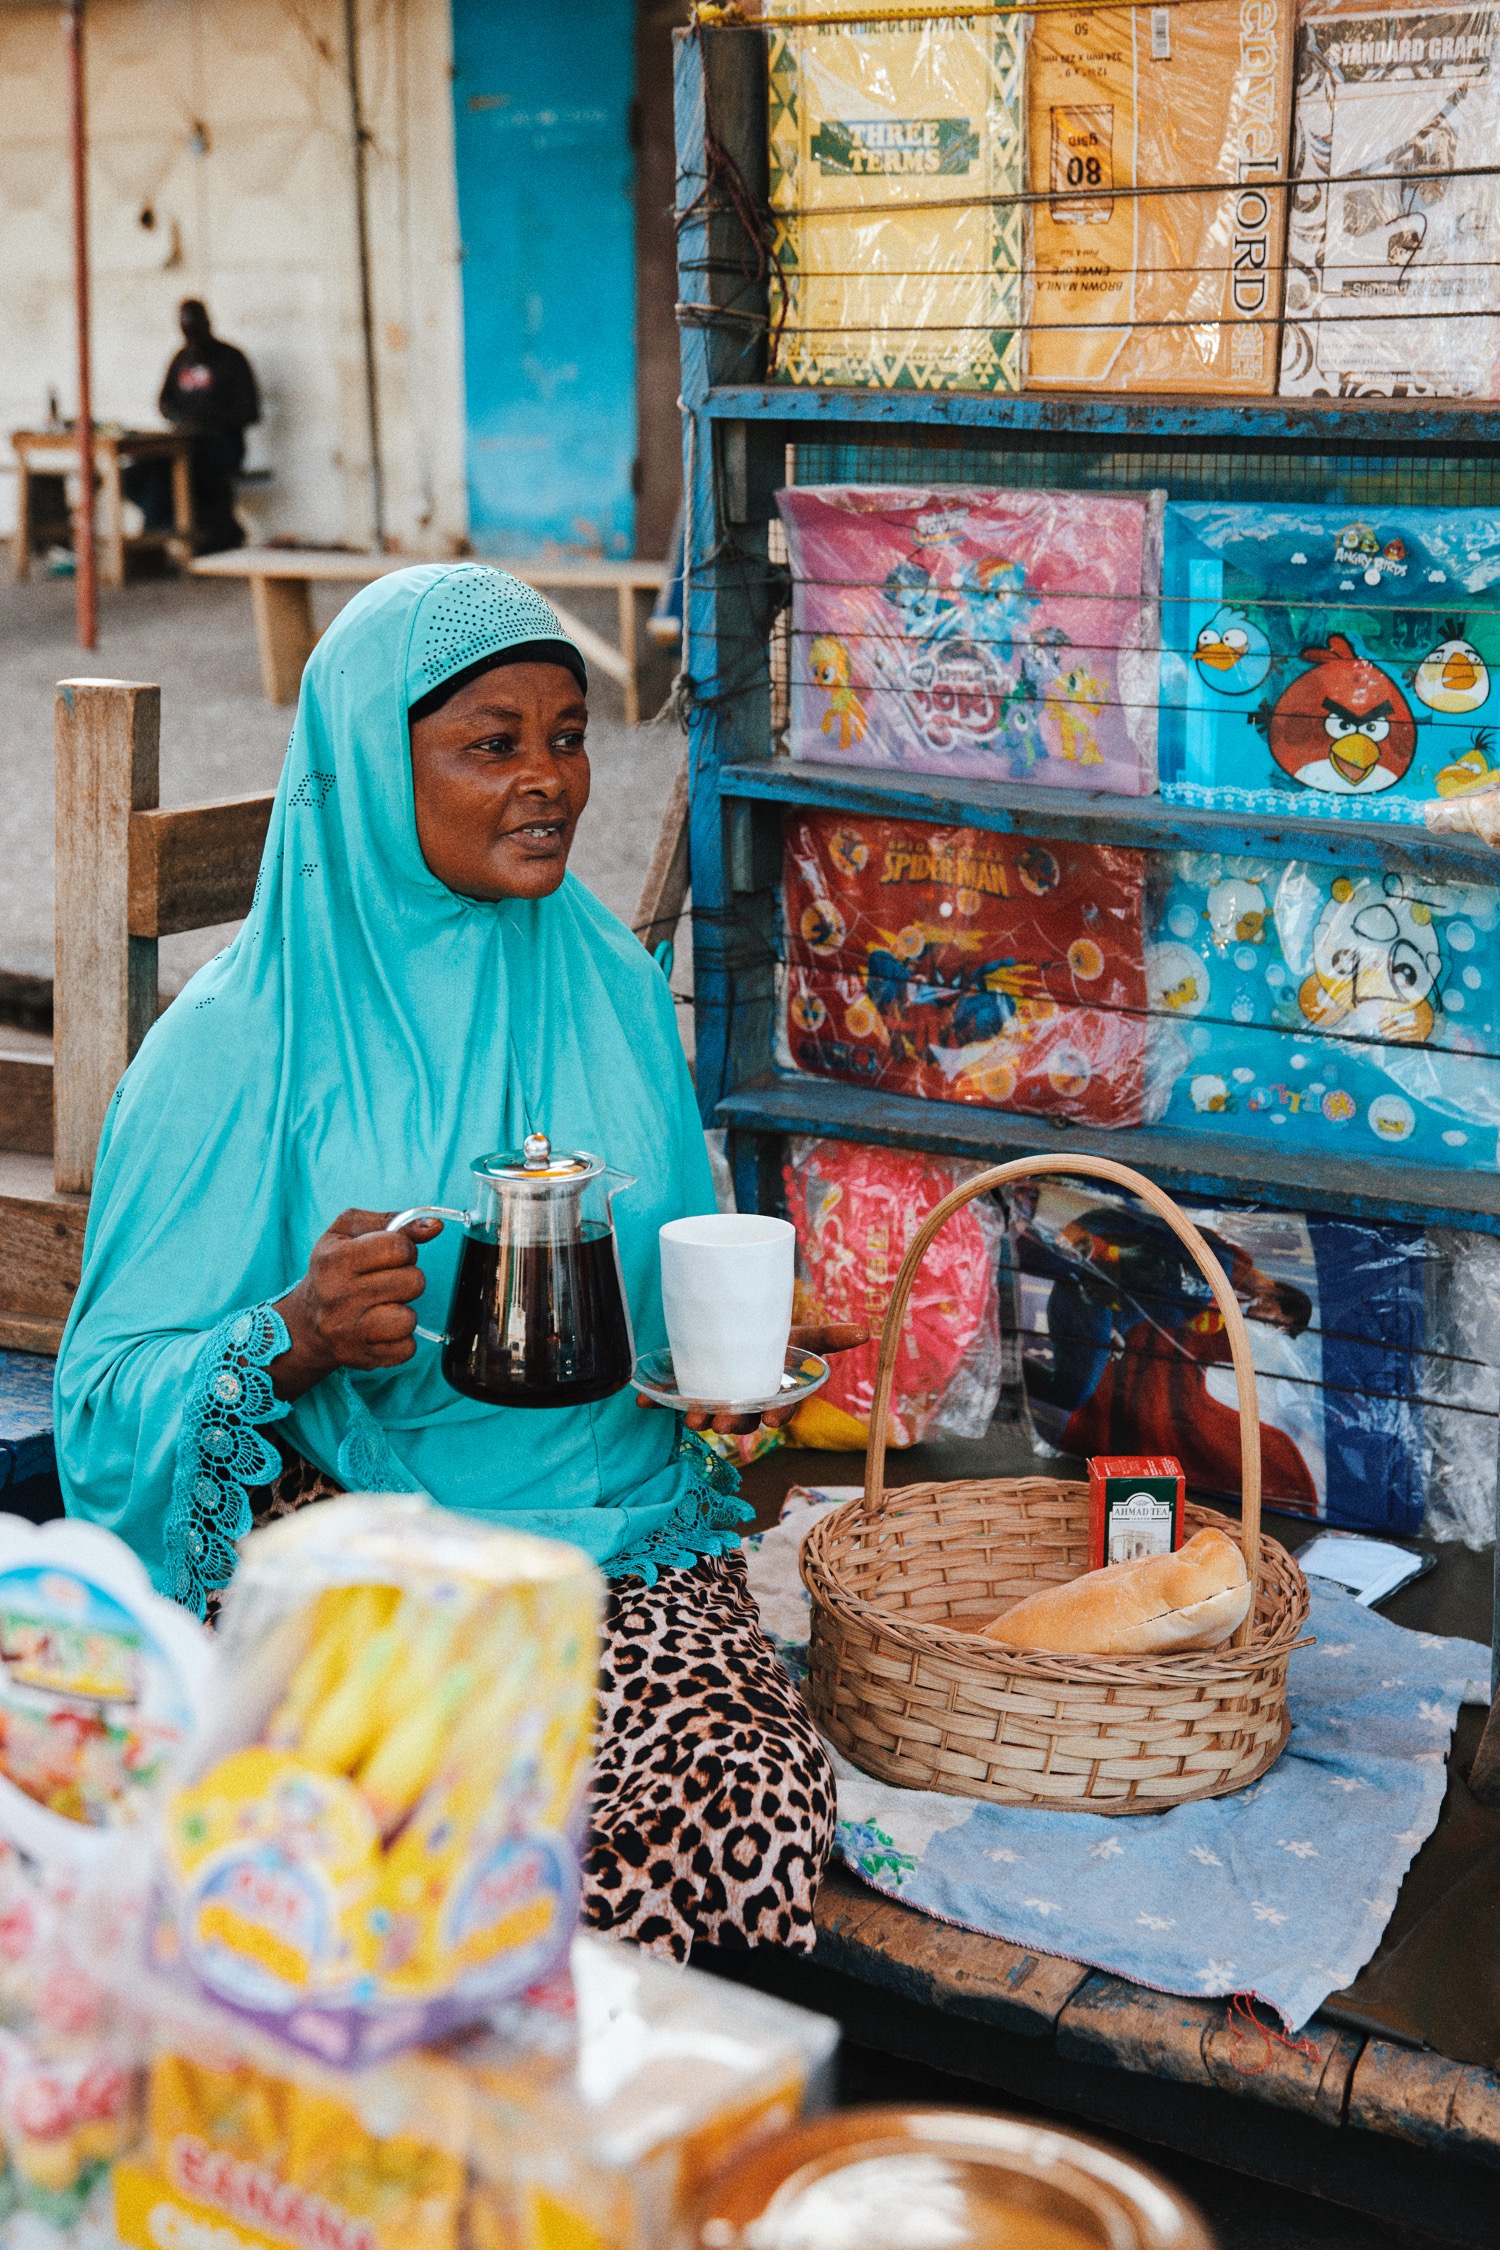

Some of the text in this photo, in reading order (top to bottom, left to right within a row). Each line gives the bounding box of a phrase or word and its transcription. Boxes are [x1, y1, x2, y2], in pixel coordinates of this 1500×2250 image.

[1074, 22, 1088, 35] 50
[1324, 38, 1425, 67] STANDARD
[848, 121, 940, 147] THREE
[848, 148, 941, 173] TERMS
[1066, 157, 1101, 186] 80
[1035, 281, 1123, 292] BROWN MANILA
[1334, 546, 1408, 577] ANGRY BIRDS
[1114, 1507, 1168, 1516] AHMAD TEA
